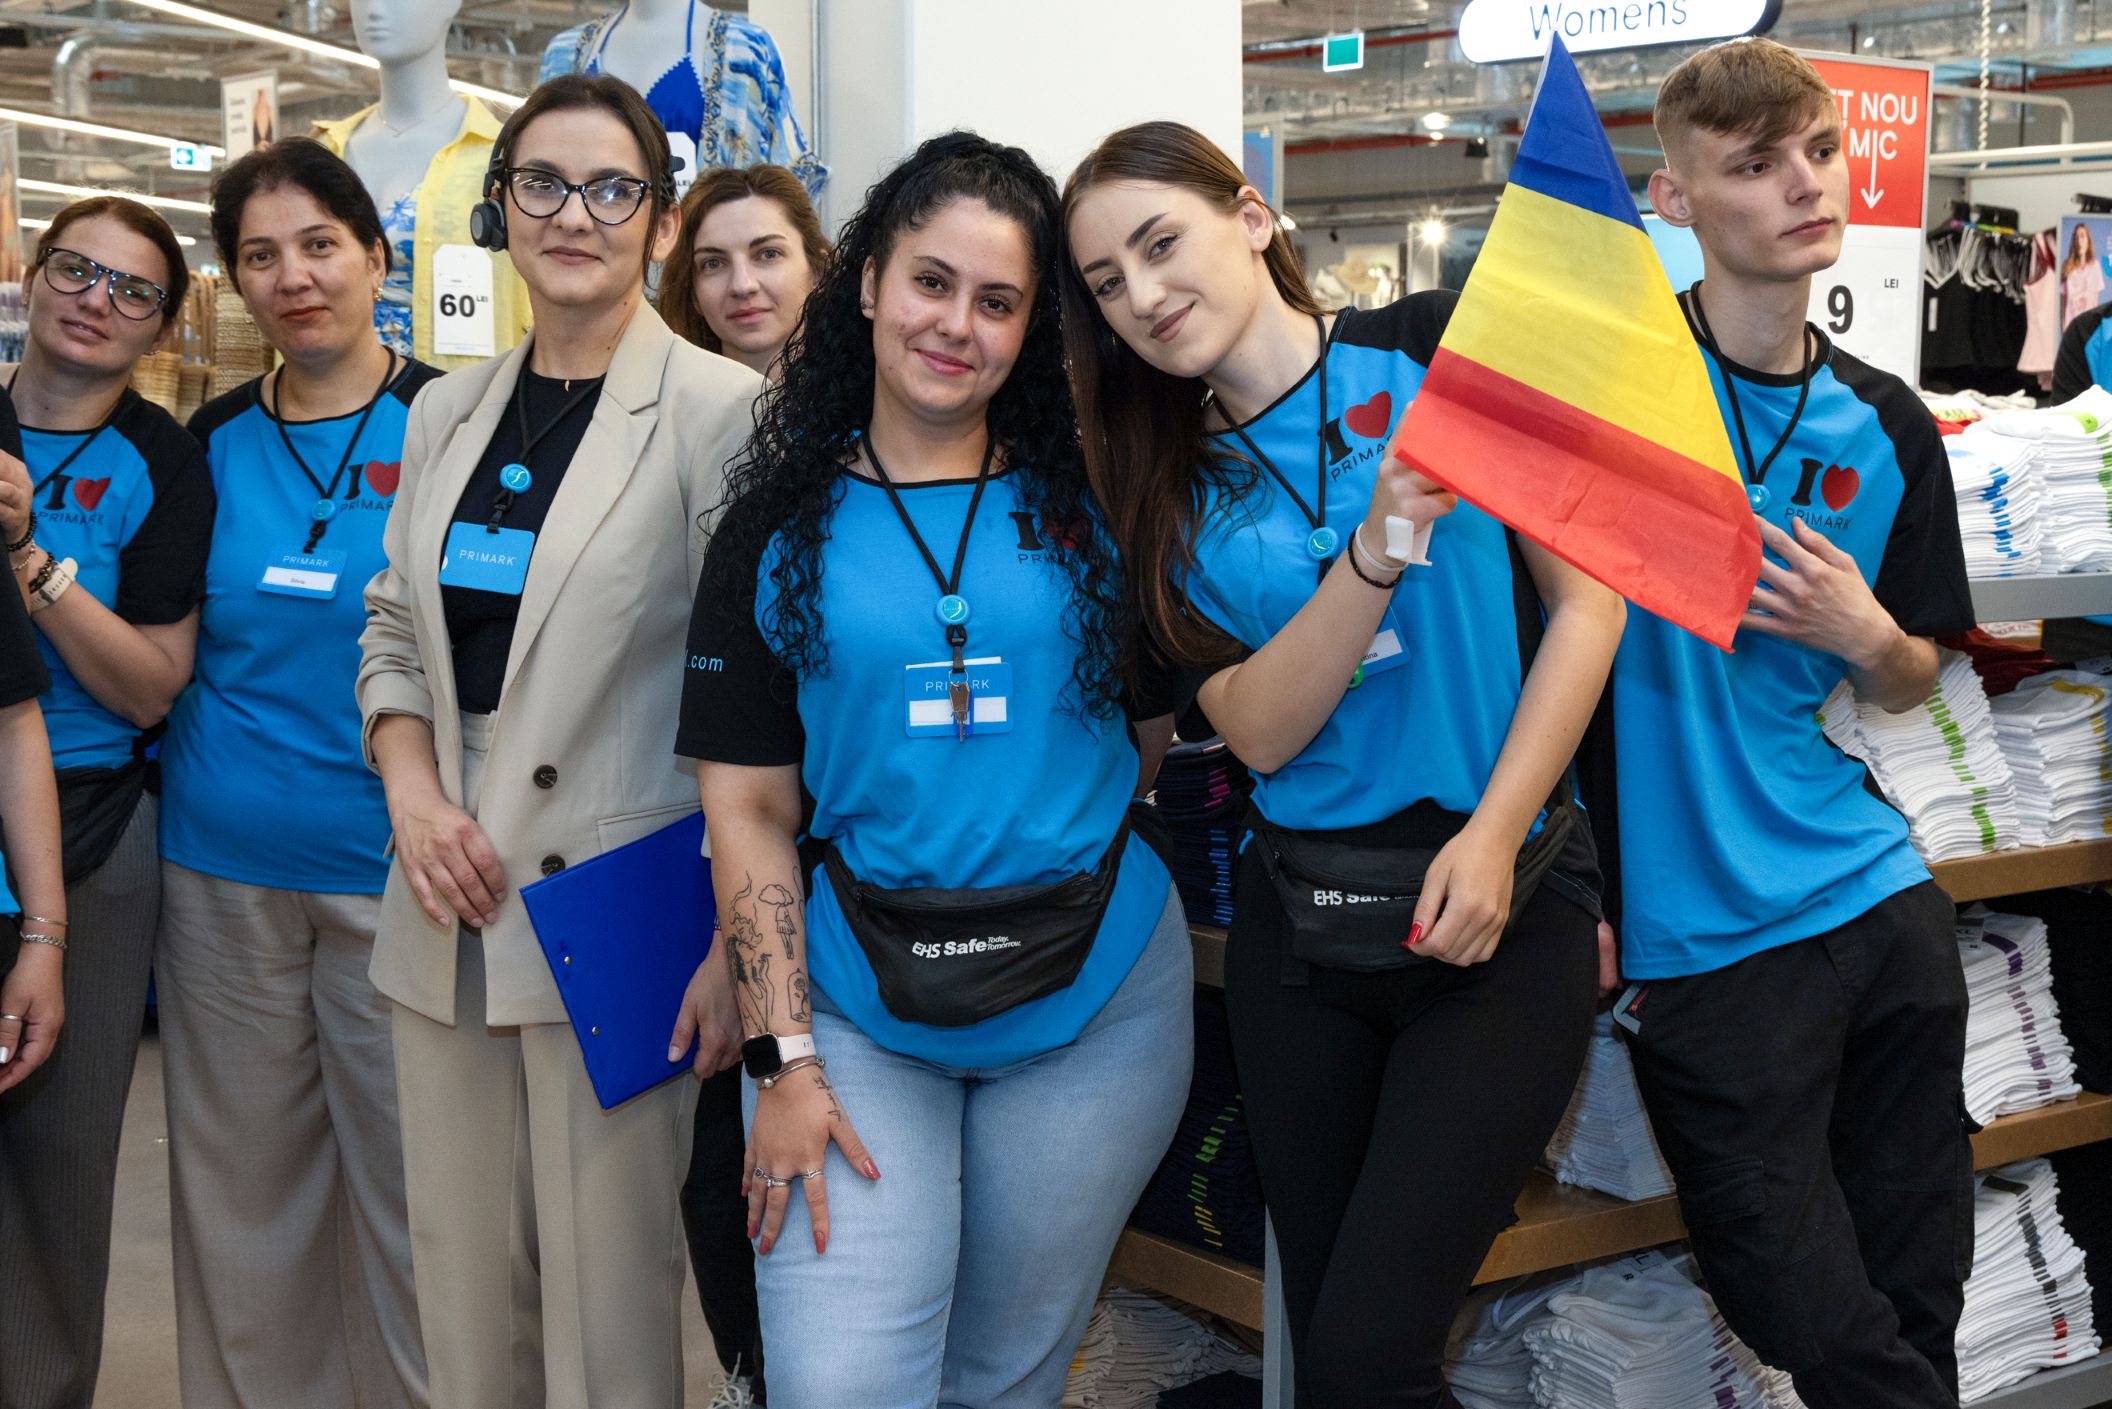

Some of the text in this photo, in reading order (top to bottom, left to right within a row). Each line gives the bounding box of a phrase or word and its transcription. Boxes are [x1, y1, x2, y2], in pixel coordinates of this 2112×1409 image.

[1530, 0, 1687, 40] Womens
[1861, 91, 1918, 125] NOU
[1848, 127, 1898, 160] MIC
[439, 293, 489, 318] 60 LEI
[1827, 278, 1899, 335] 9 LEI
[1317, 416, 1353, 466] I
[1330, 435, 1392, 483] PRIMA
[44, 474, 74, 511] I
[343, 463, 364, 501] I
[1790, 457, 1824, 506] I
[38, 511, 105, 525] PRIMARK
[340, 499, 394, 513] PRIMAR
[1784, 507, 1851, 531] PRIMARK
[1007, 511, 1045, 551] I
[282, 555, 329, 568] PRIMARK
[460, 549, 514, 567] PRIMARK
[925, 679, 989, 692] PRIRK
[1313, 890, 1343, 906] EHS
[912, 938, 987, 959] EHS Safe
